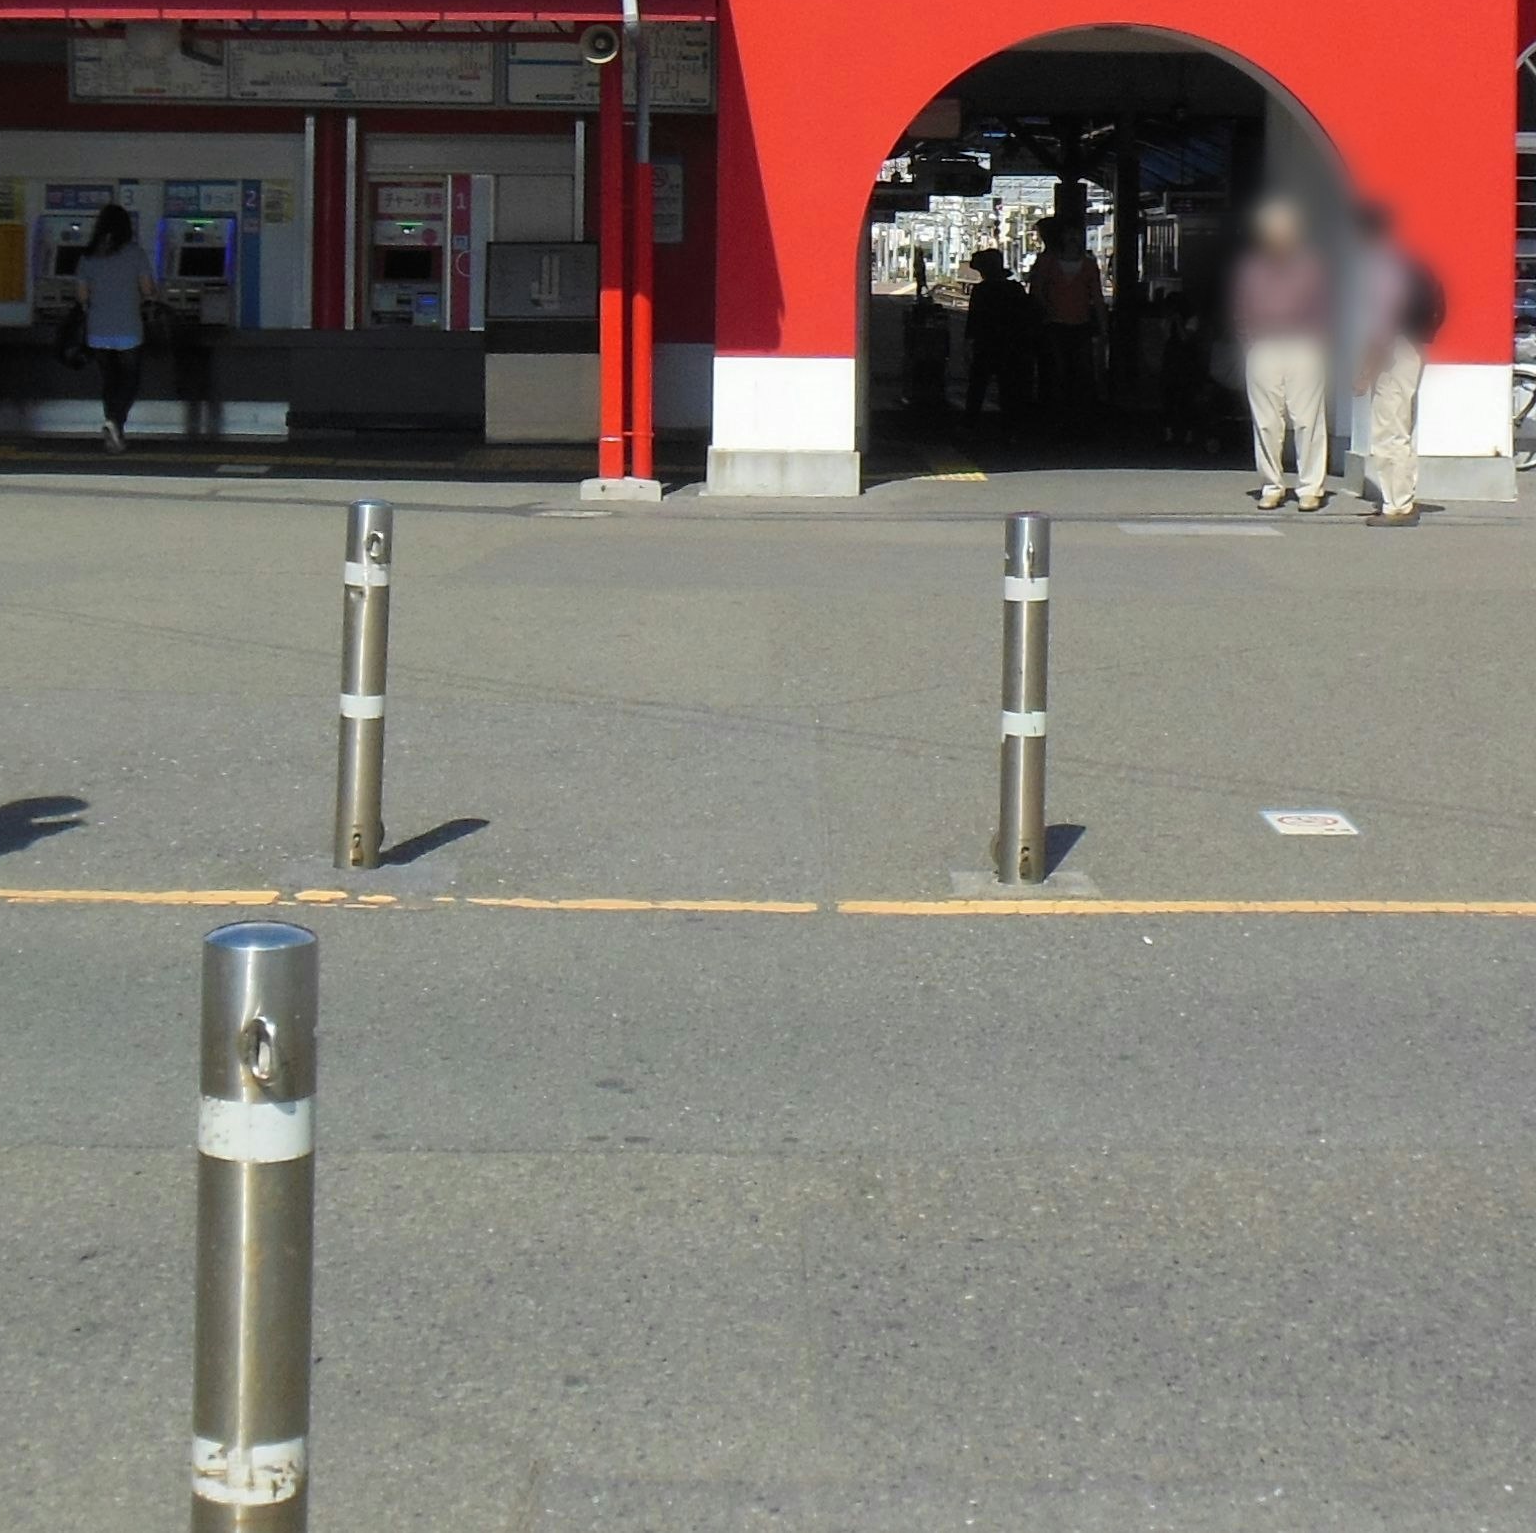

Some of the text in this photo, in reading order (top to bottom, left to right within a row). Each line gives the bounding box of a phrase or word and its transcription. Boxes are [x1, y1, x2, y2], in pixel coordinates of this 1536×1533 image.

[123, 188, 134, 206] 3
[245, 189, 256, 207] 2
[456, 192, 467, 210] 1
